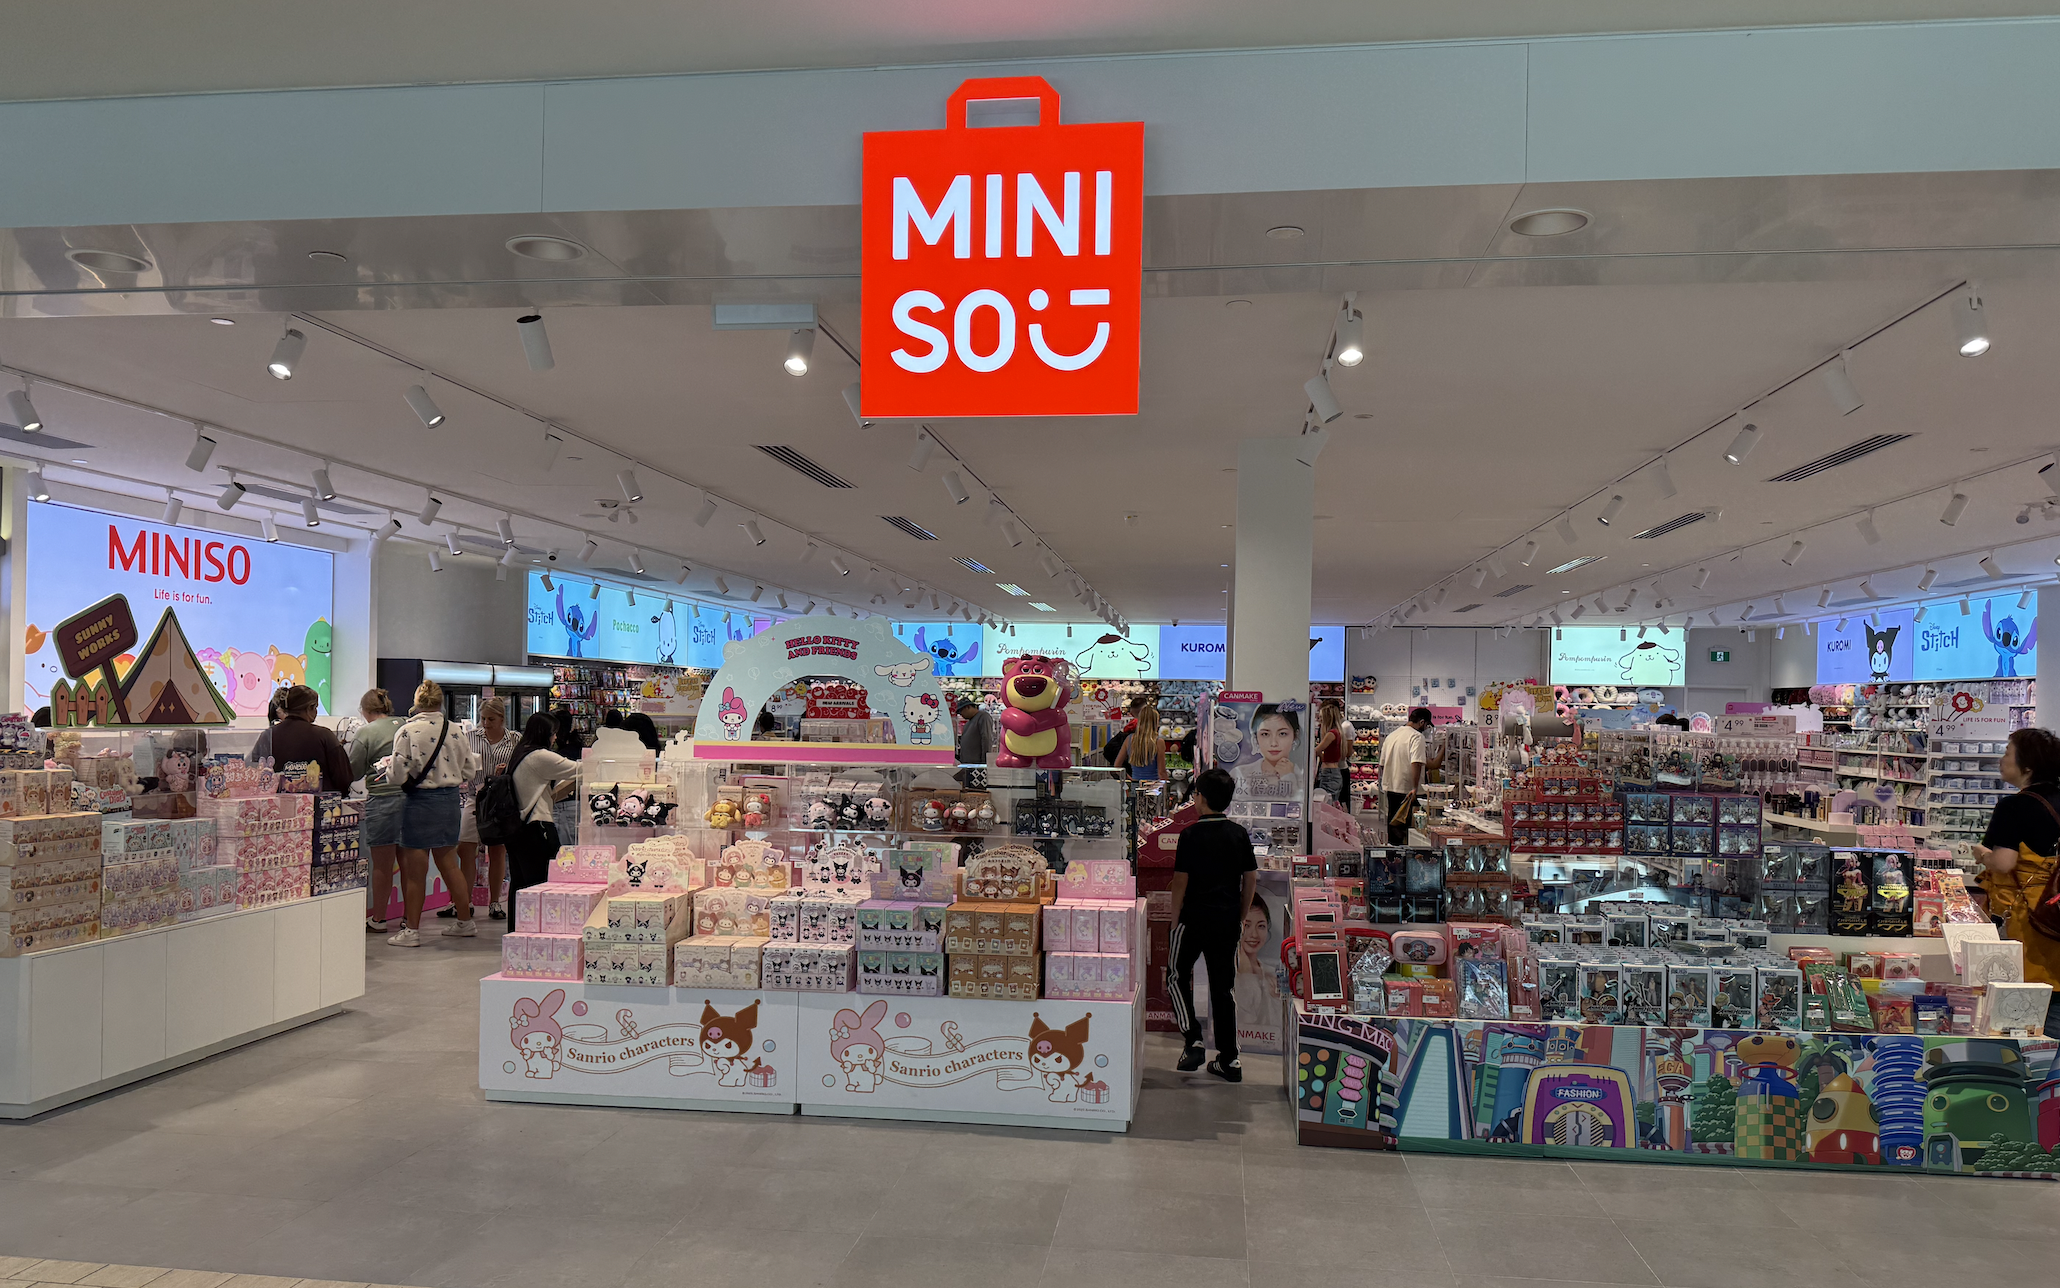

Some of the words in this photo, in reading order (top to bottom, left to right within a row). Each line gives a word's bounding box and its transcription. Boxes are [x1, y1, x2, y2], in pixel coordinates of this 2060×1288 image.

[893, 171, 1112, 260] MINI
[890, 289, 1016, 373] SO
[108, 524, 251, 585] MINISO
[154, 589, 170, 601] Life
[173, 591, 180, 602] is
[182, 591, 195, 603] for
[196, 592, 213, 604] fun.
[74, 614, 114, 645] SUNNY
[612, 619, 640, 633] Pochacco
[77, 629, 120, 661] WORKS
[785, 635, 822, 650] HELLO
[822, 635, 860, 650] KITTY
[1181, 643, 1225, 653] KUROM
[1827, 639, 1852, 653] KUROMI
[787, 647, 811, 660] AND
[811, 646, 858, 660] FRIENDS
[1223, 692, 1258, 700] CANMAKE
[1276, 699, 1305, 712] New
[567, 1047, 616, 1064] Sanrio
[619, 1036, 695, 1060] characters
[889, 1060, 940, 1078] Sanrio
[944, 1048, 1023, 1075] characters
[1558, 1089, 1599, 1098] FASHION
